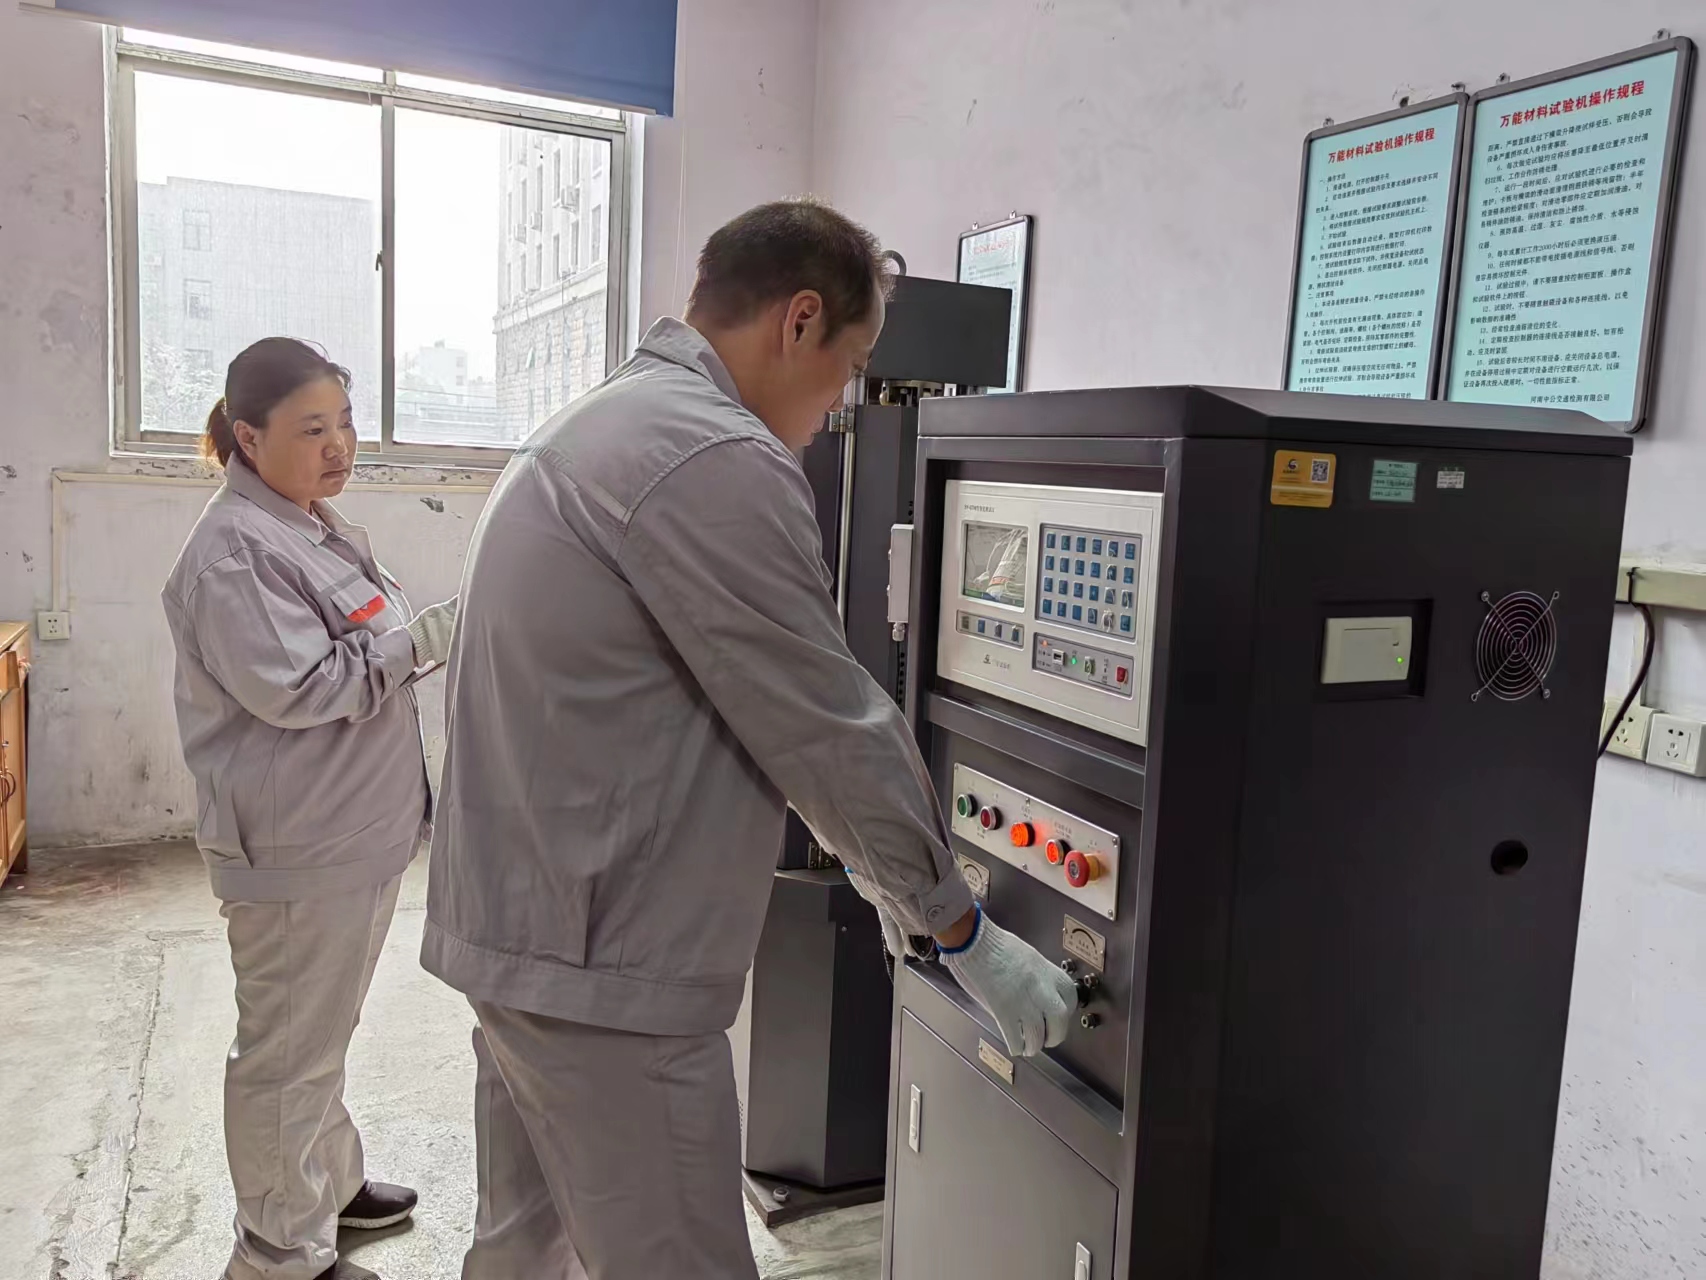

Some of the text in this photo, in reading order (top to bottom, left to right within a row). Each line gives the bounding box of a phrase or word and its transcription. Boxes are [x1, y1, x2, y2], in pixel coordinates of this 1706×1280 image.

[1499, 81, 1645, 128] 万能材料试验机操作规程
[1327, 127, 1435, 164] 万能材料试验机操作规程
